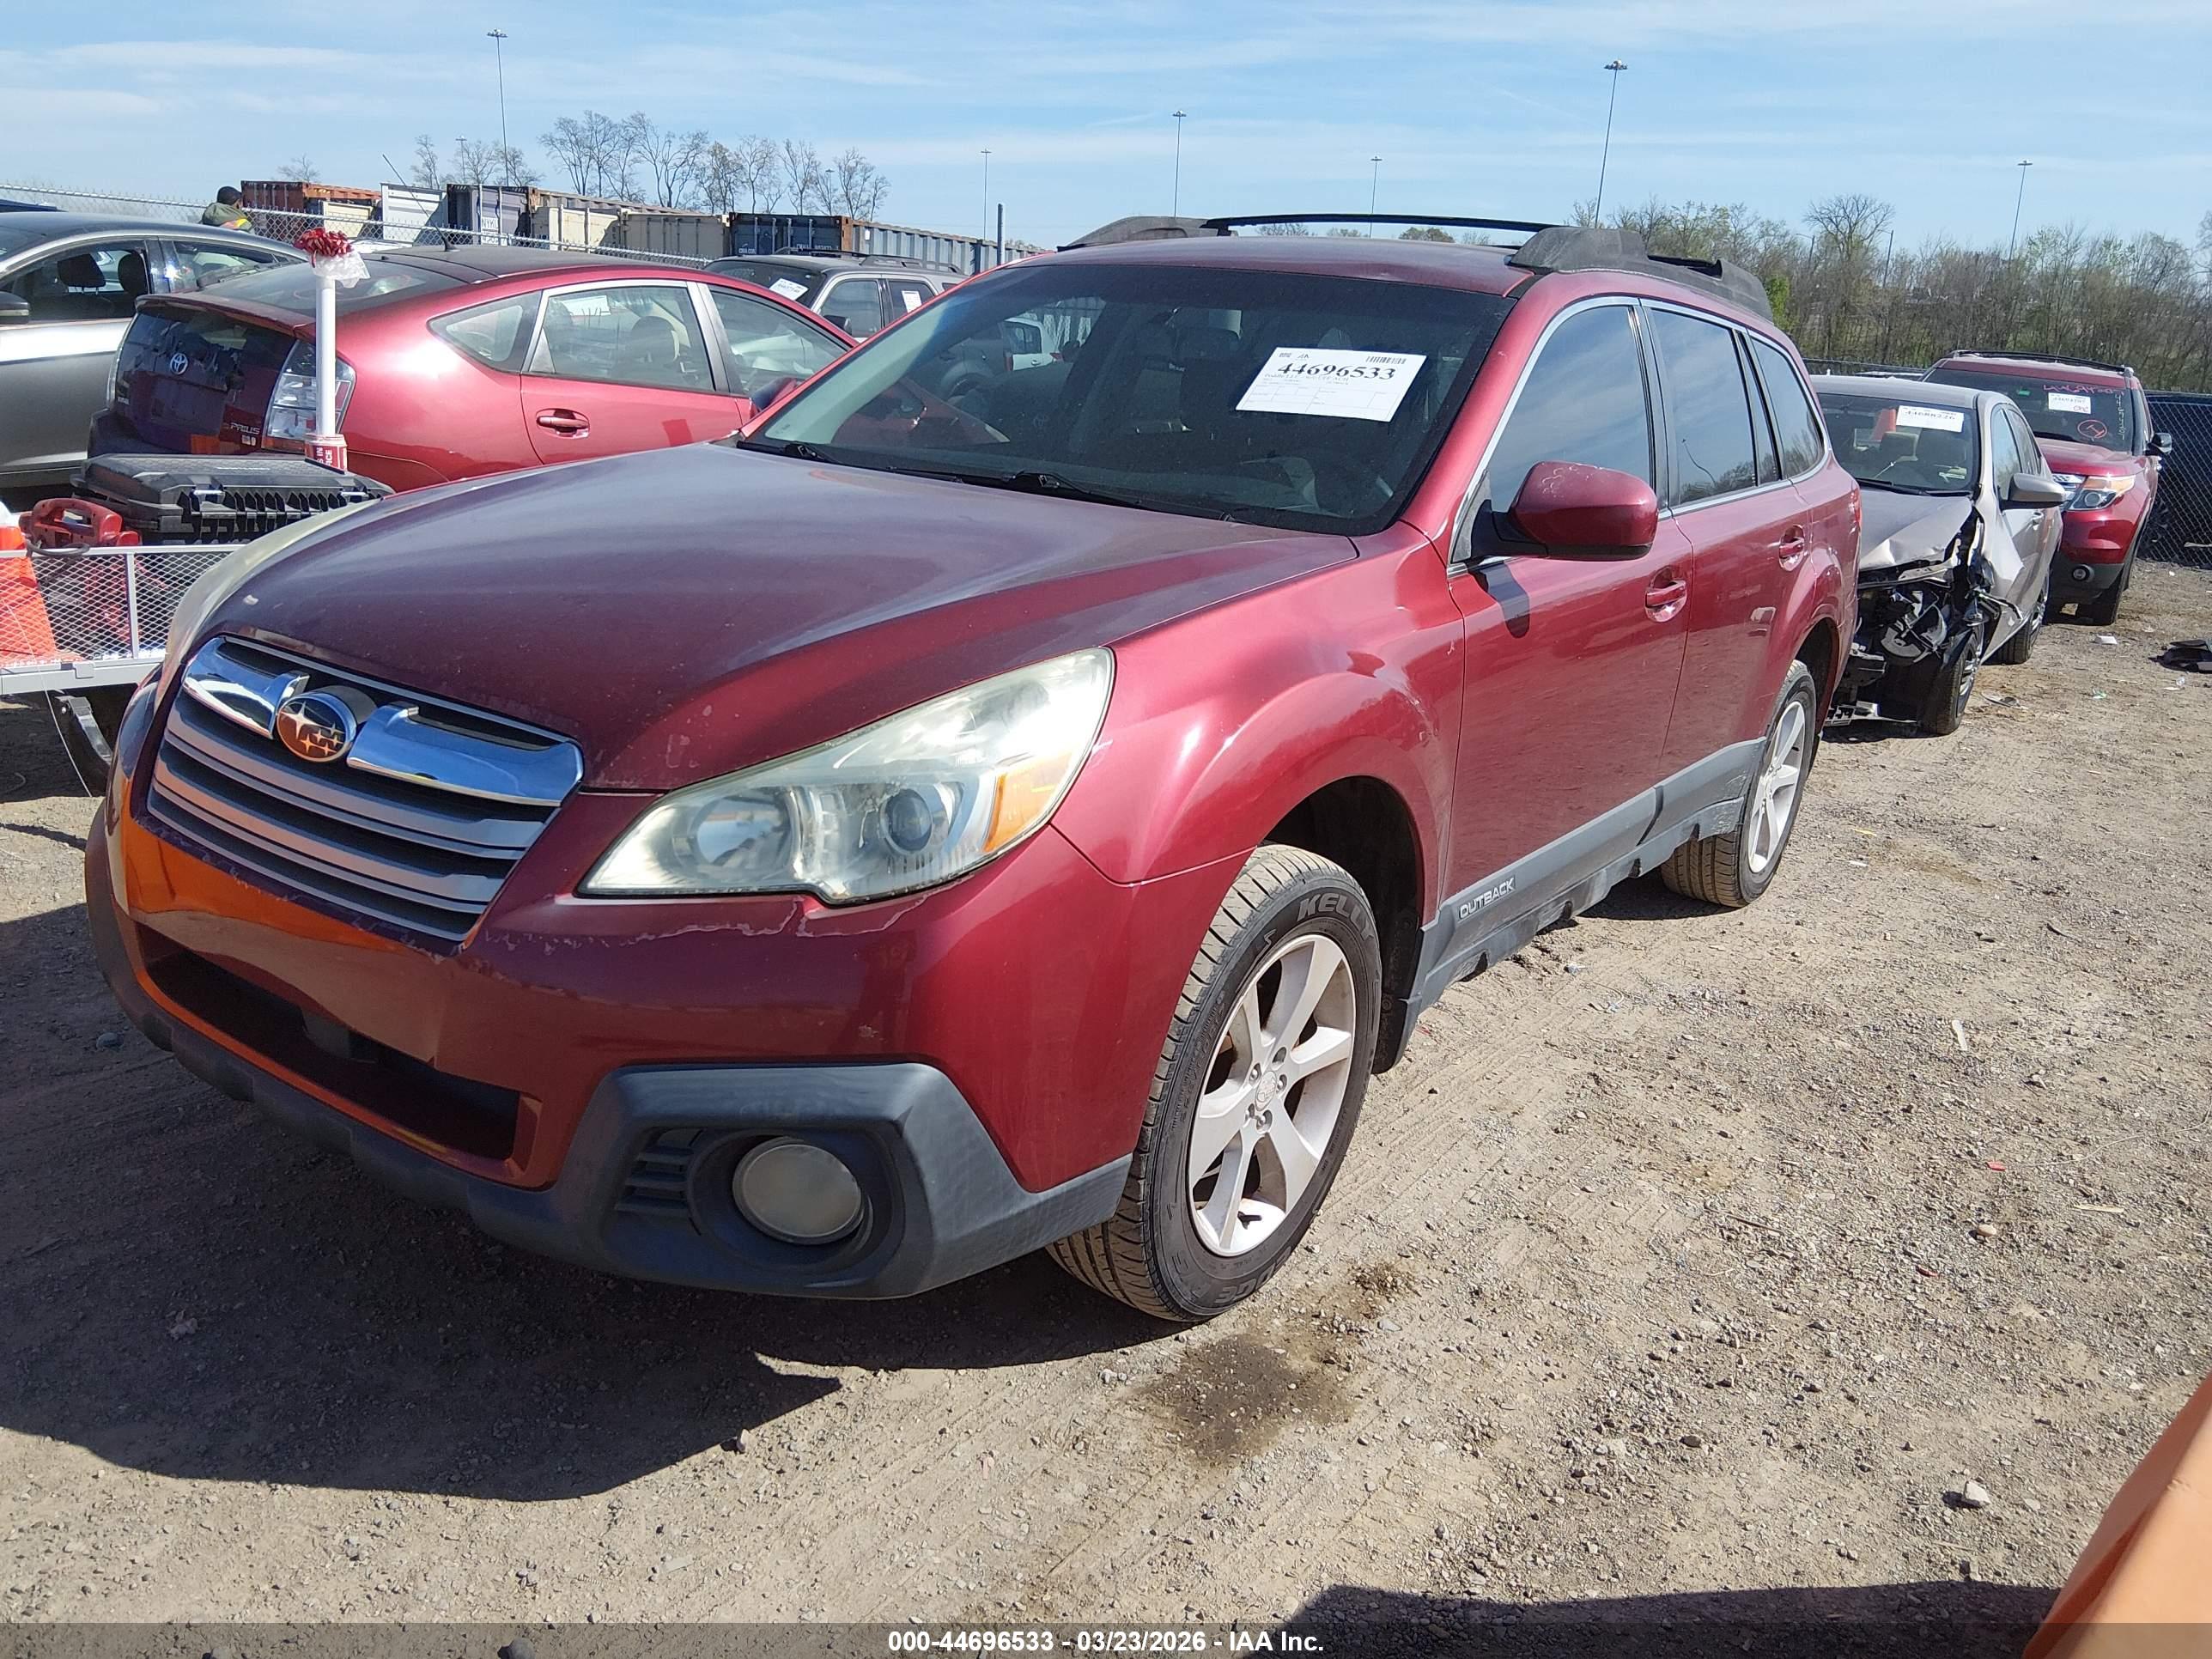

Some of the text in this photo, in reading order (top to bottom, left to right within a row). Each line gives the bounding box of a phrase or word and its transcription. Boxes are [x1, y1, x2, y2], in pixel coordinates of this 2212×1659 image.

[1278, 362, 1396, 380] 44696533
[230, 422, 261, 434] PRIUS
[1459, 878, 1516, 919] OUTBACK
[1297, 892, 1376, 941] KELLY
